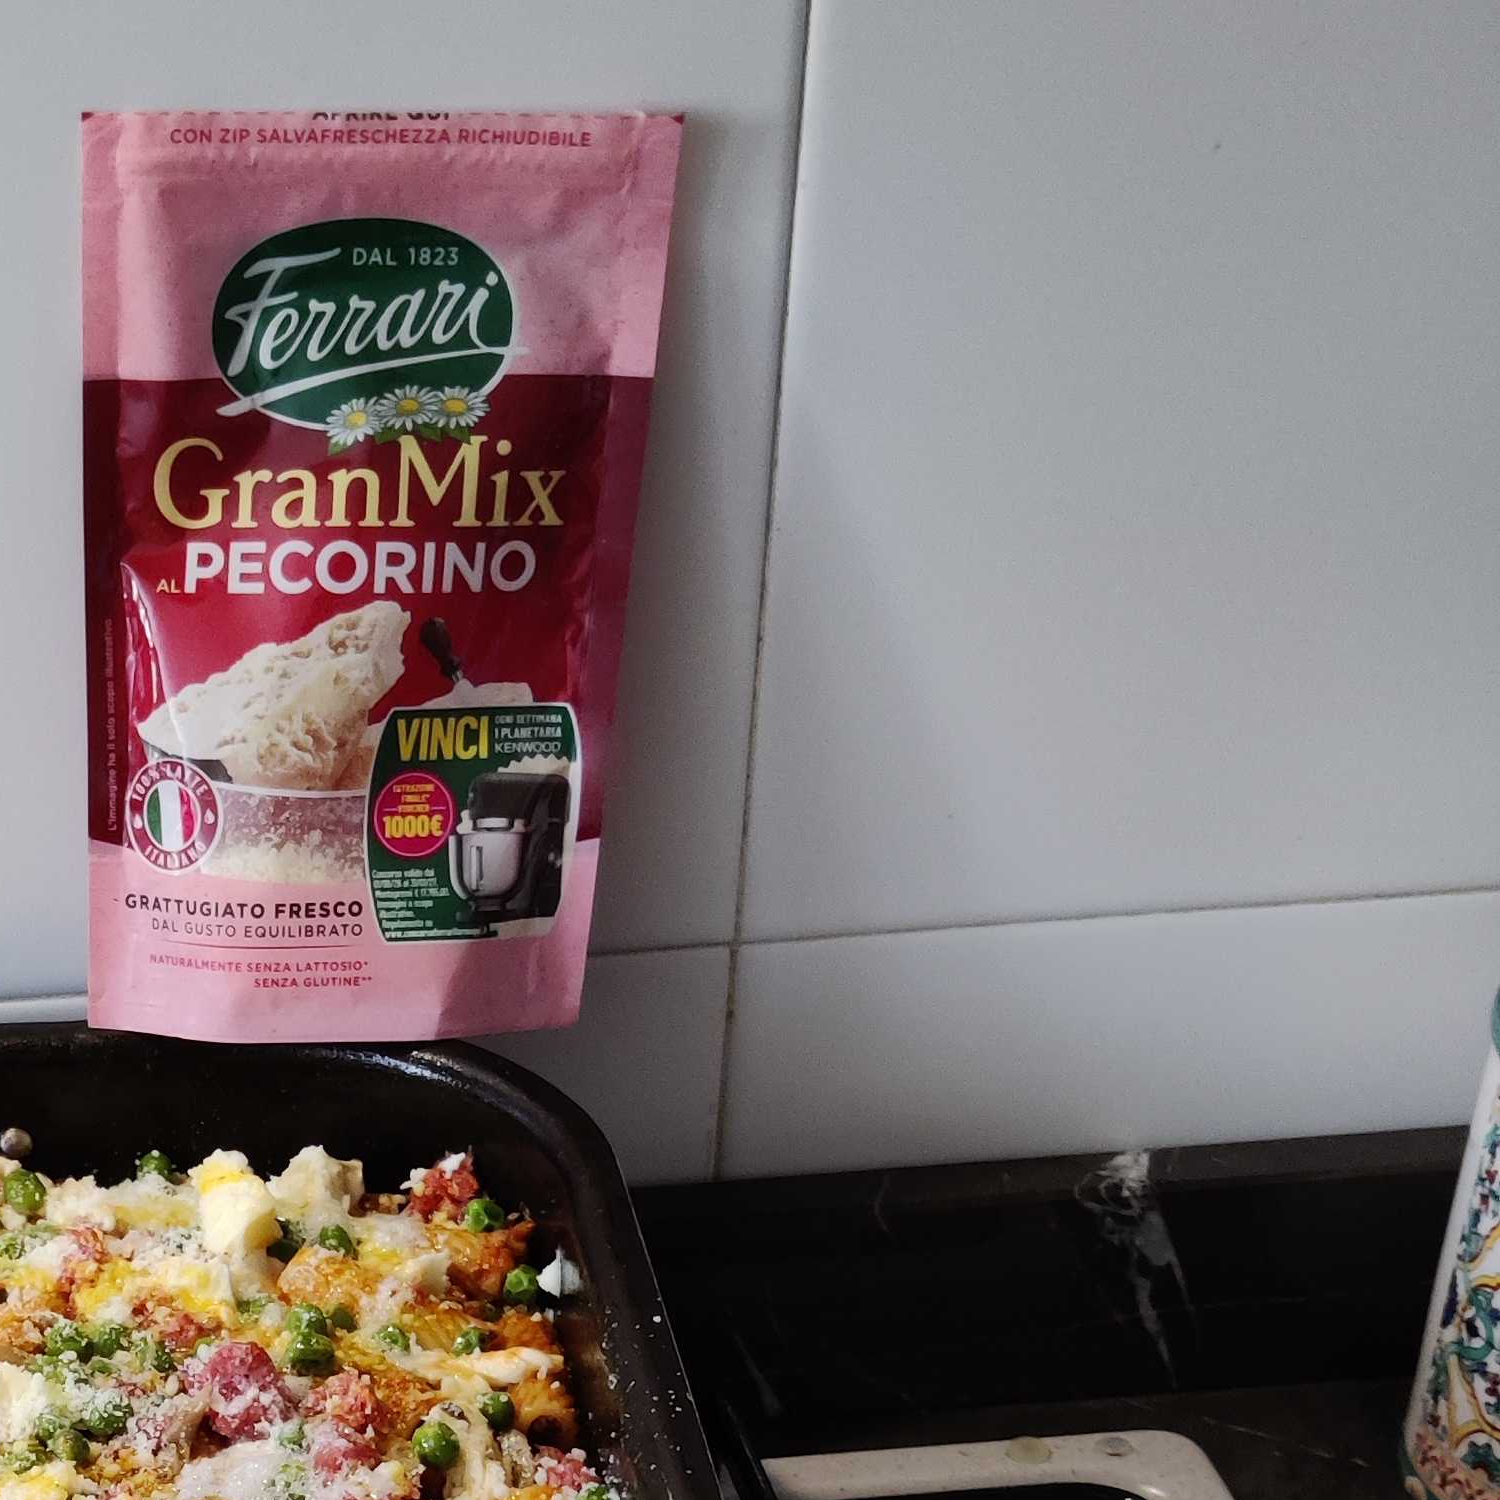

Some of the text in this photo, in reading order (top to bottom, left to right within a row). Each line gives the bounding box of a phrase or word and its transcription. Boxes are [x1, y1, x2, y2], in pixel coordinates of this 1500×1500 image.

[170, 128, 592, 148] CON ZIP SALVAFRESCHEZZA RICHIUDIBILE
[352, 247, 460, 266] DAL 1823
[224, 247, 499, 379] Ferrari
[153, 433, 567, 530] GranMix
[155, 539, 537, 595] AL PECORINO
[396, 715, 490, 762] VINCI
[494, 741, 562, 753] KENWOOD
[382, 814, 444, 839] 1000€
[124, 893, 364, 919] GRATTUGIATO FRESCO
[151, 918, 178, 933] DAL
[184, 921, 237, 938] GUSTO
[243, 923, 363, 939] EQUILIBRATO
[150, 953, 242, 973] NATURALMENTE
[246, 962, 291, 973] SENZA
[254, 977, 299, 988] SENZA
